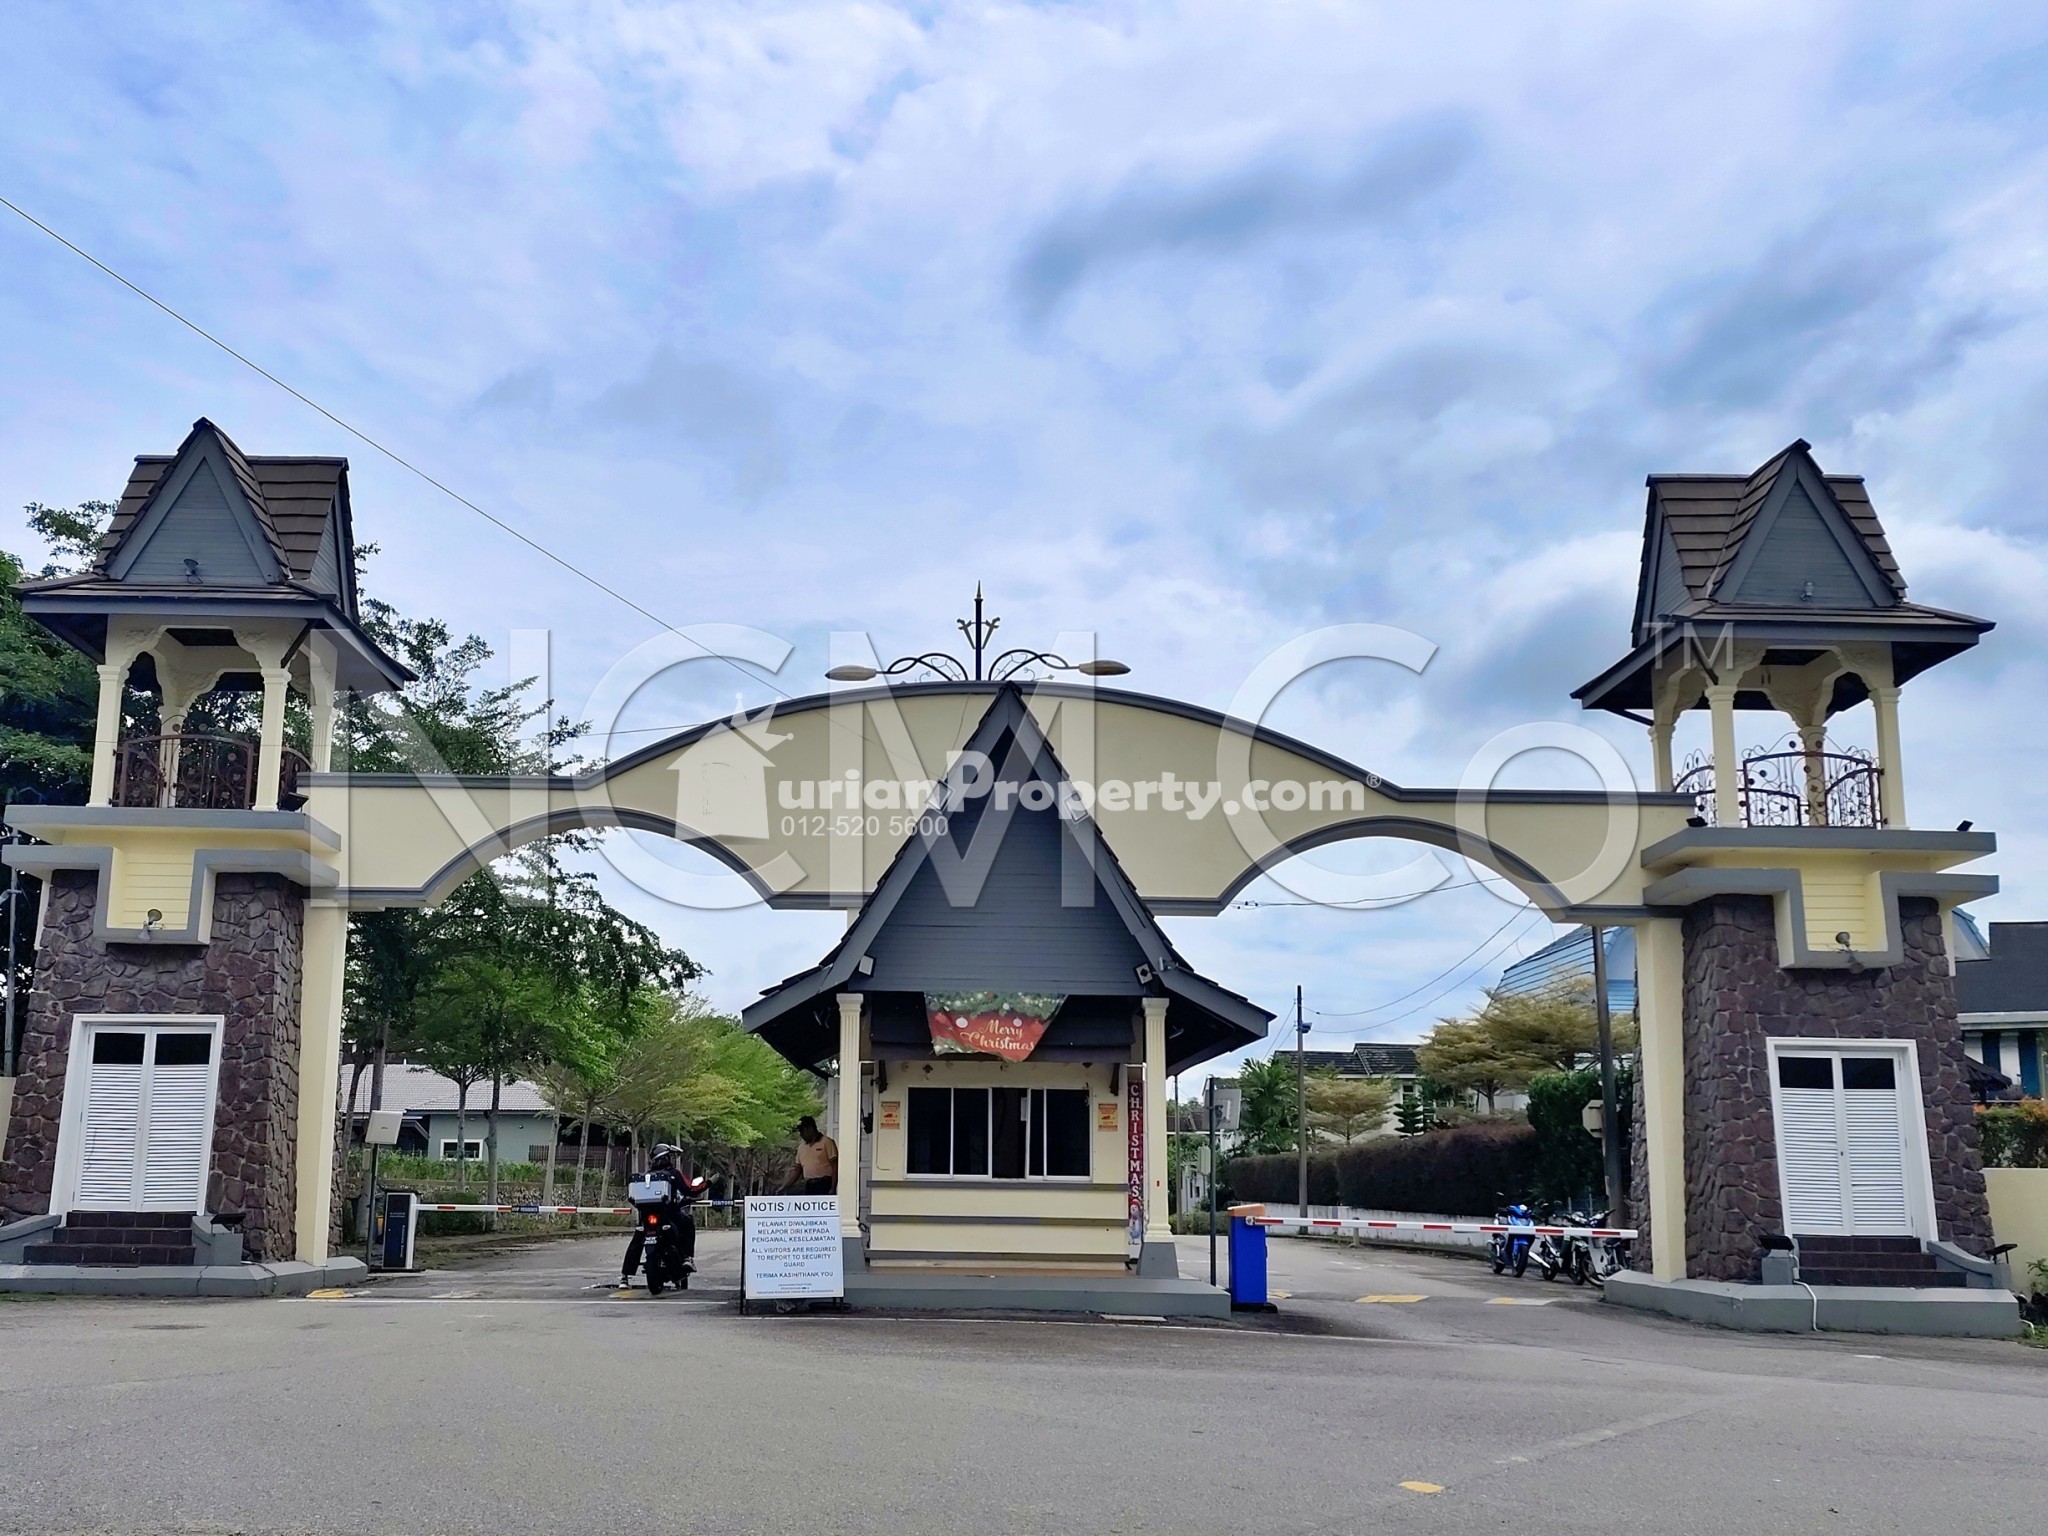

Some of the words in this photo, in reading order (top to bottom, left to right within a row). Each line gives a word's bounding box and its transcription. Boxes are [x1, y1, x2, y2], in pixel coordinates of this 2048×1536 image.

[979, 1019, 1024, 1040] Merry
[960, 1031, 1035, 1051] Christmas
[1129, 1084, 1141, 1197] CHRISTMAS
[750, 1202, 785, 1212] NOTIS
[794, 1201, 836, 1211] NOTICE
